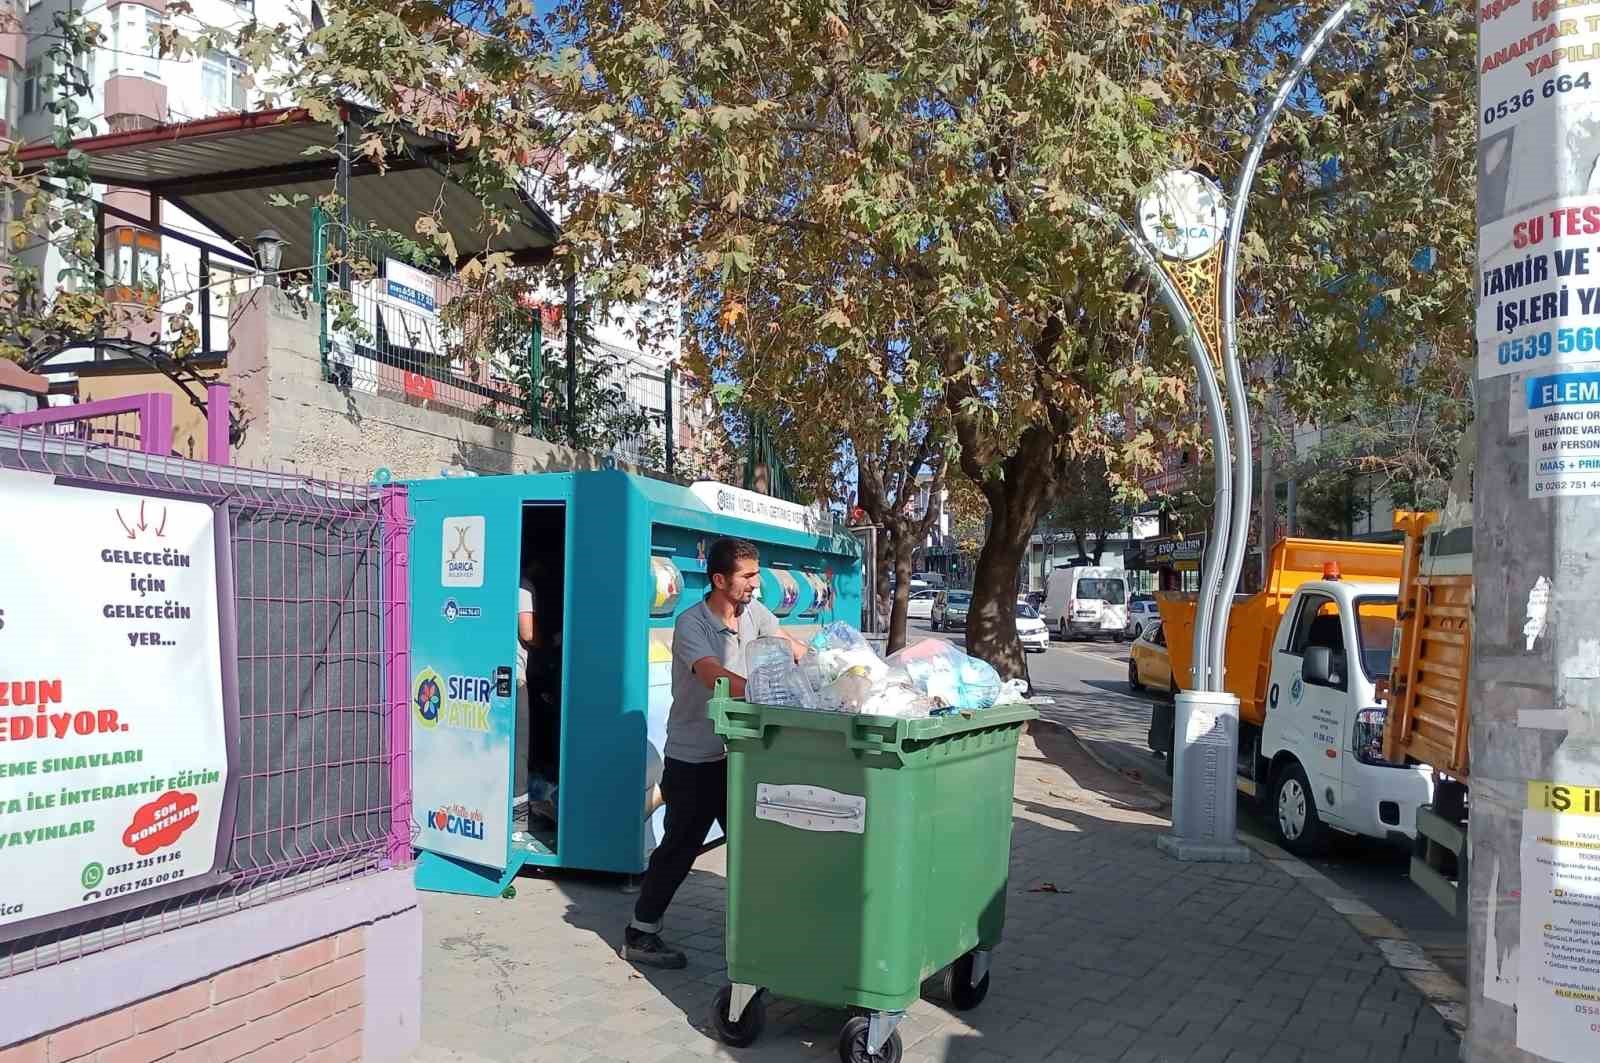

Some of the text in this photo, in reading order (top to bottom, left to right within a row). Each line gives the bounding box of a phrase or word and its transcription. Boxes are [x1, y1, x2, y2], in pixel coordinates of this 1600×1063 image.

[1481, 19, 1578, 73] ANAHTAR
[1484, 71, 1591, 124] 0536 664
[1513, 215, 1543, 249] SU
[1484, 247, 1589, 297] TAMİR VE
[1497, 285, 1568, 334] İŞLERİ
[1498, 331, 1552, 365] 0539
[1544, 412, 1583, 422] YABANCI
[1535, 424, 1578, 438] ÜRETİMDE
[1542, 441, 1558, 451] BAY
[1540, 460, 1565, 472] MAAŞ
[1545, 480, 1567, 490] 0262
[1571, 481, 1586, 489] 751
[101, 547, 190, 567] GELECEĞİN
[130, 572, 165, 597] İÇİN
[103, 600, 190, 619] GELECEĞİN
[449, 677, 490, 702] SIFIR
[449, 703, 490, 730] ATIK
[42, 749, 143, 774] SINAVLARI
[27, 792, 56, 811] İLE
[60, 776, 165, 806] İNTERAKTİF
[168, 768, 220, 790] EĞİTİM
